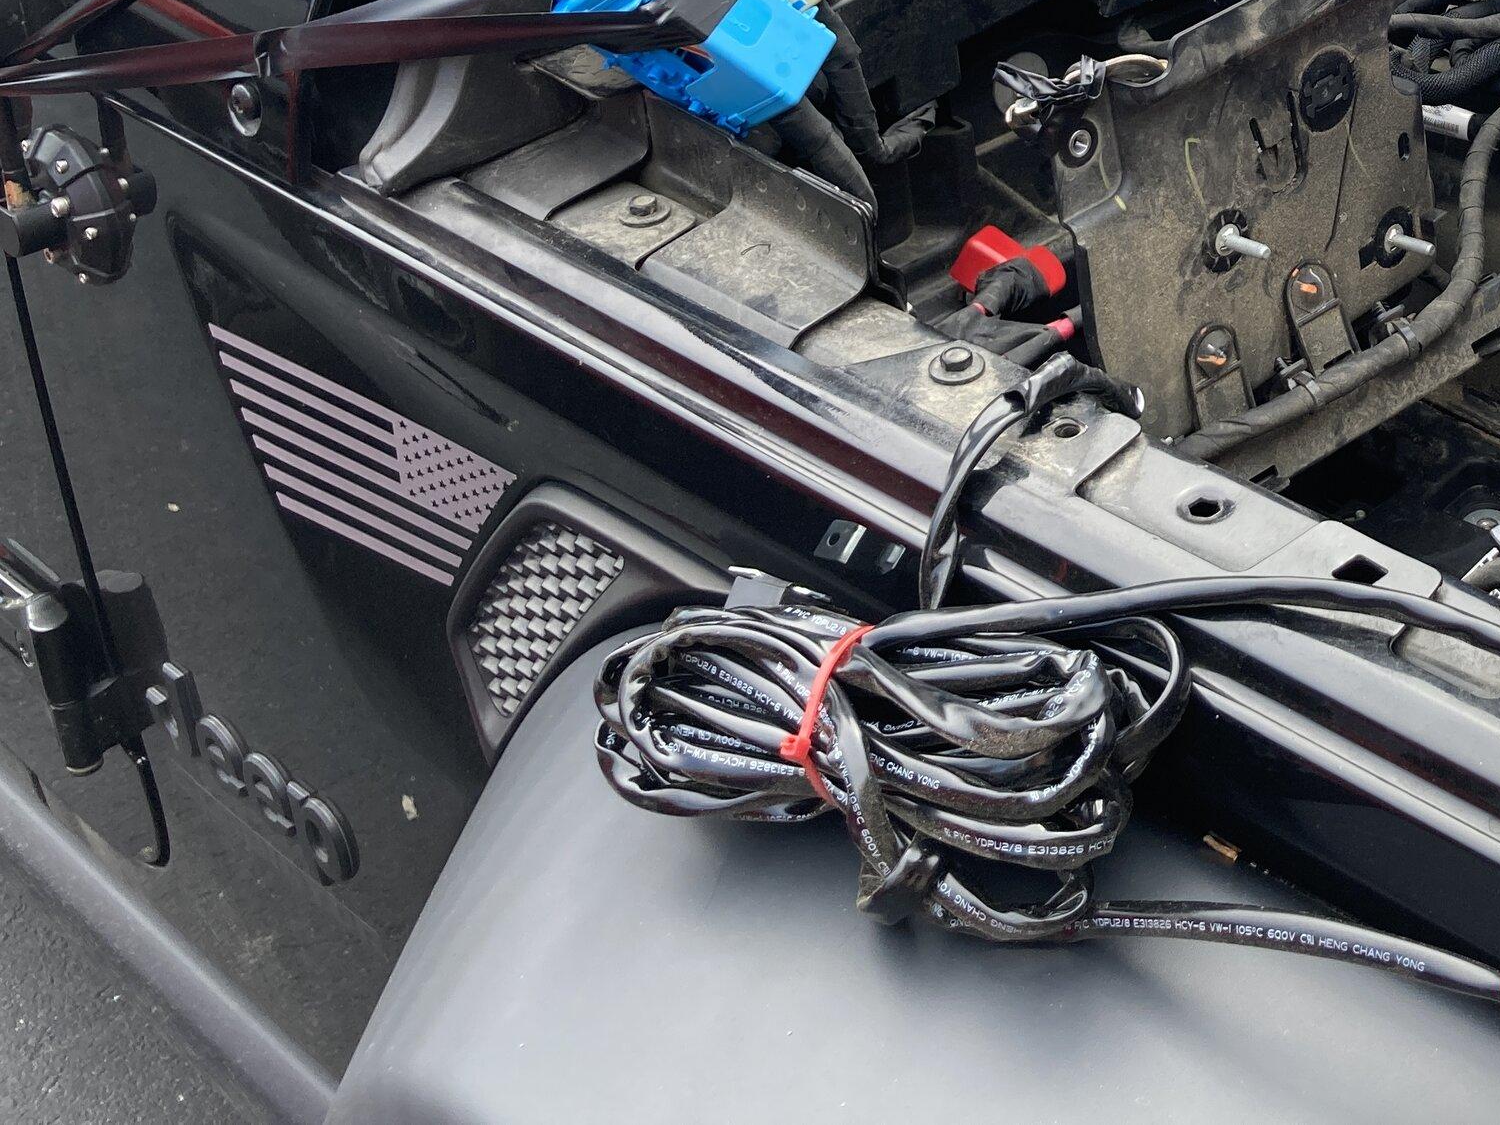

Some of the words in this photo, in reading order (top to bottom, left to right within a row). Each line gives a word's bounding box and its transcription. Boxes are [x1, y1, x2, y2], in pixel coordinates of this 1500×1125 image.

[886, 760, 915, 781] CHANG
[916, 773, 941, 791] YONG
[974, 836, 1023, 853] YDPU2/8
[1028, 845, 1084, 855] E313826
[953, 894, 988, 921] CHANG
[1092, 918, 1131, 928] YDPU2/8
[1133, 918, 1172, 930] E313826
[1175, 920, 1206, 932] HCY-6
[1209, 922, 1232, 934] VW-1
[1267, 928, 1297, 942] 600V
[1318, 937, 1349, 952] HENG
[1353, 943, 1391, 962] CHANG
[1396, 955, 1426, 972] YONG
